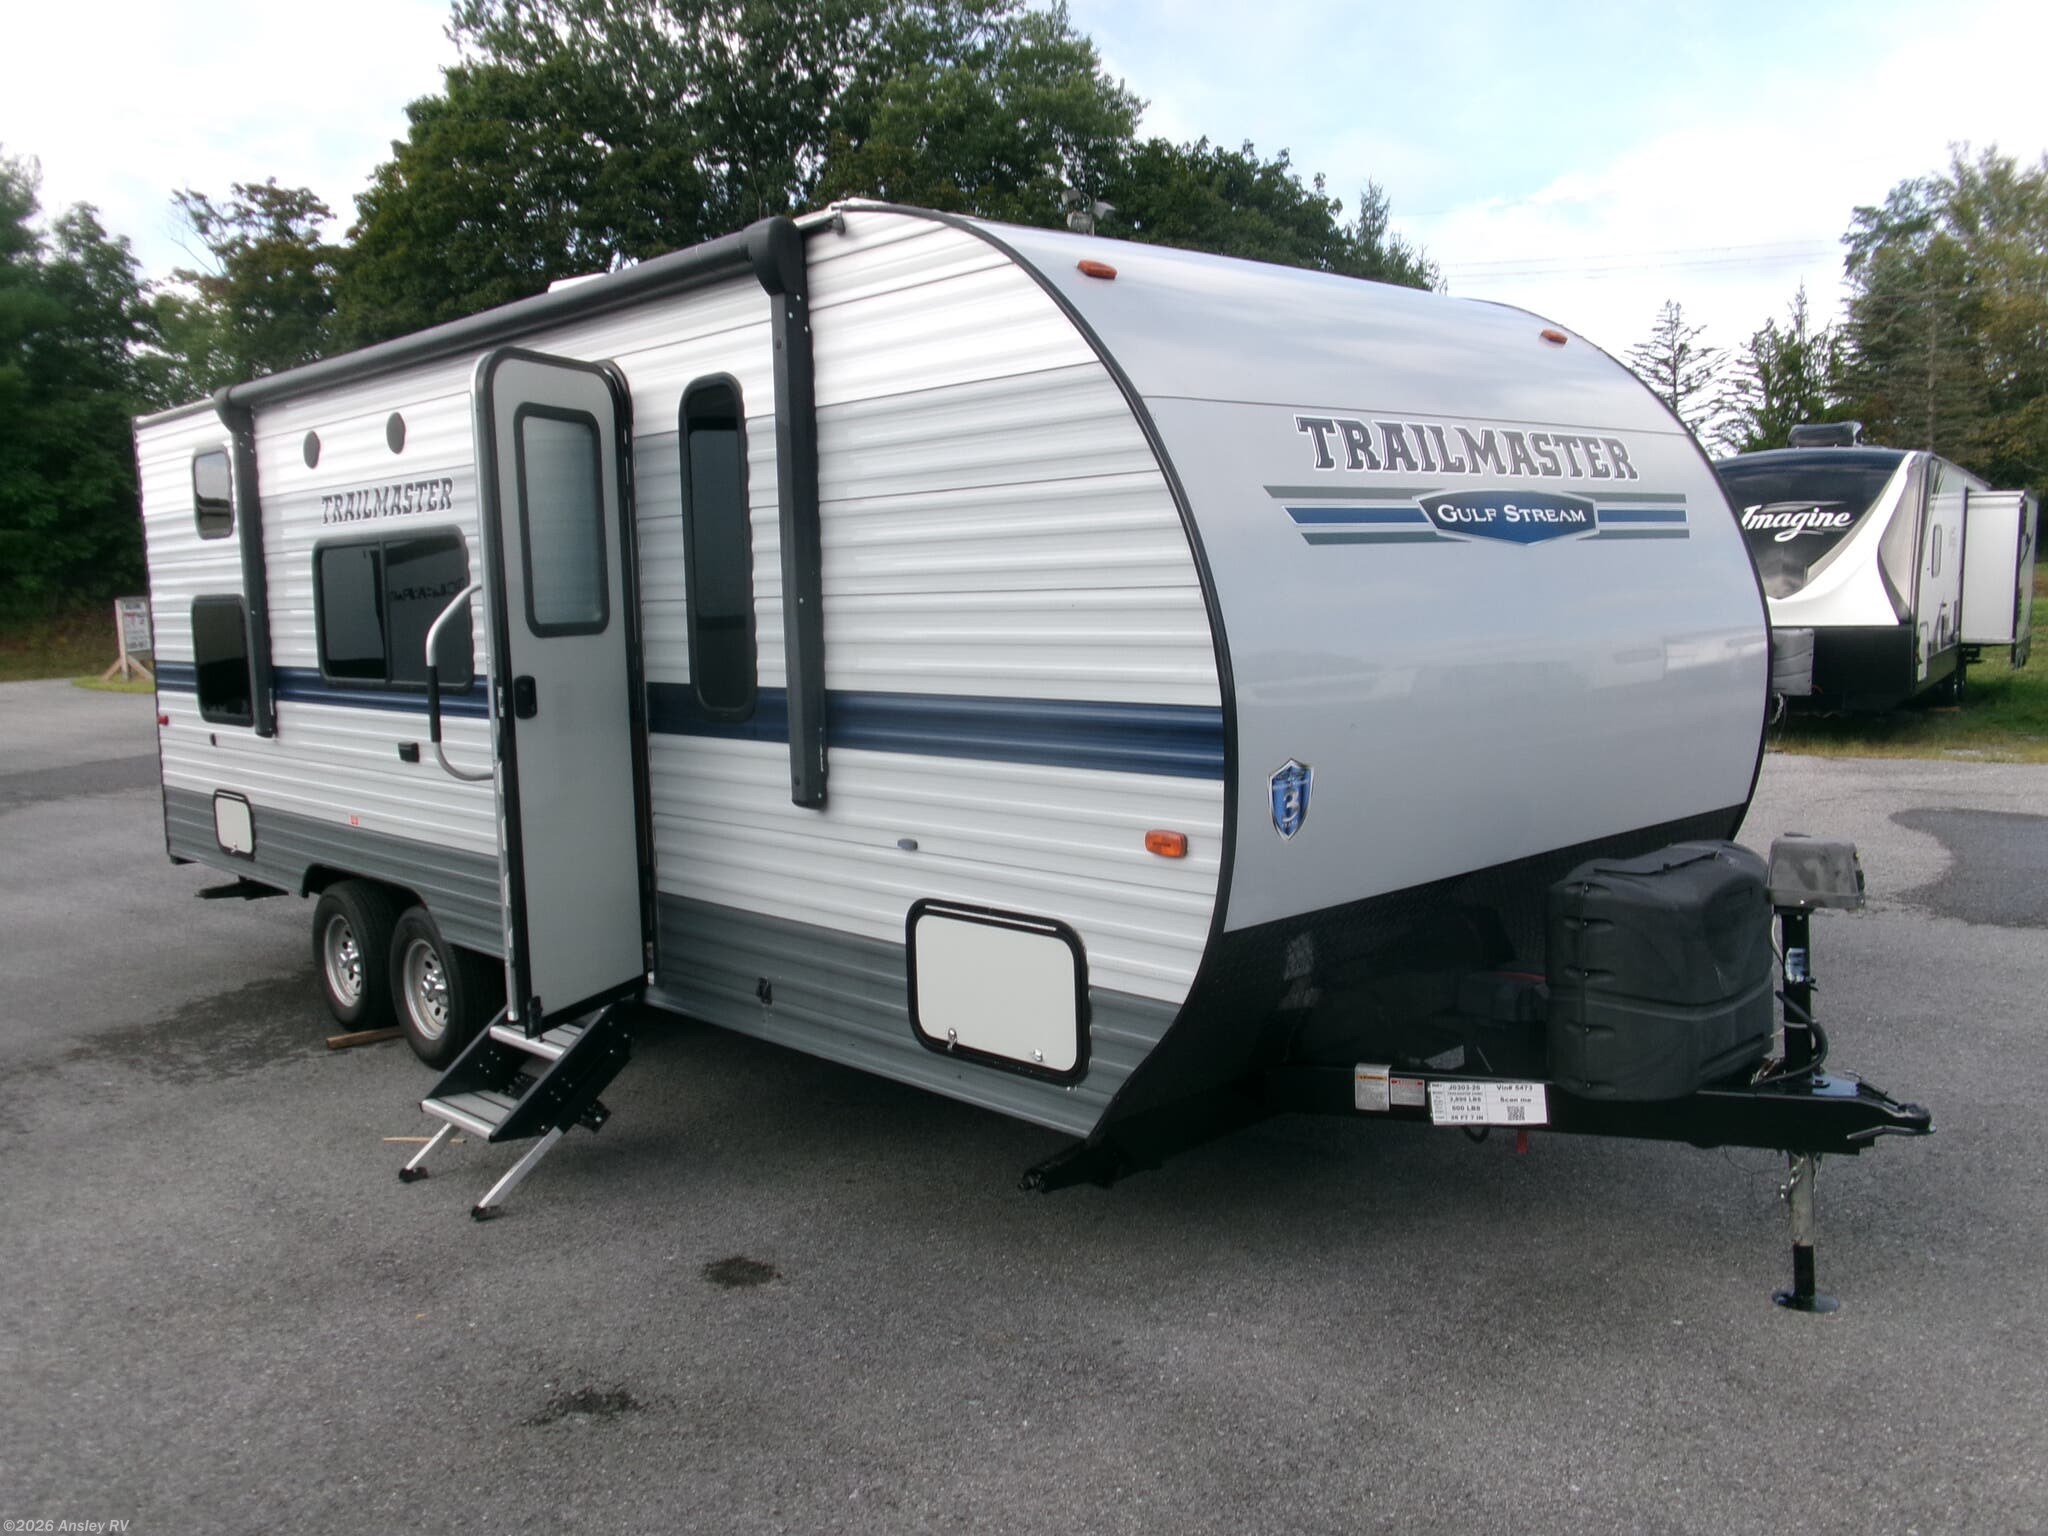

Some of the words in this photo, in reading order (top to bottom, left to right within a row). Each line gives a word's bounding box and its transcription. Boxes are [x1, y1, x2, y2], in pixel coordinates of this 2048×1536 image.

[1294, 414, 1639, 481] TRAILMASTER
[321, 477, 454, 524] TRAILMASTER
[1437, 504, 1497, 524] GULF
[1504, 505, 1586, 524] STREAM
[1741, 504, 1855, 543] Imagine
